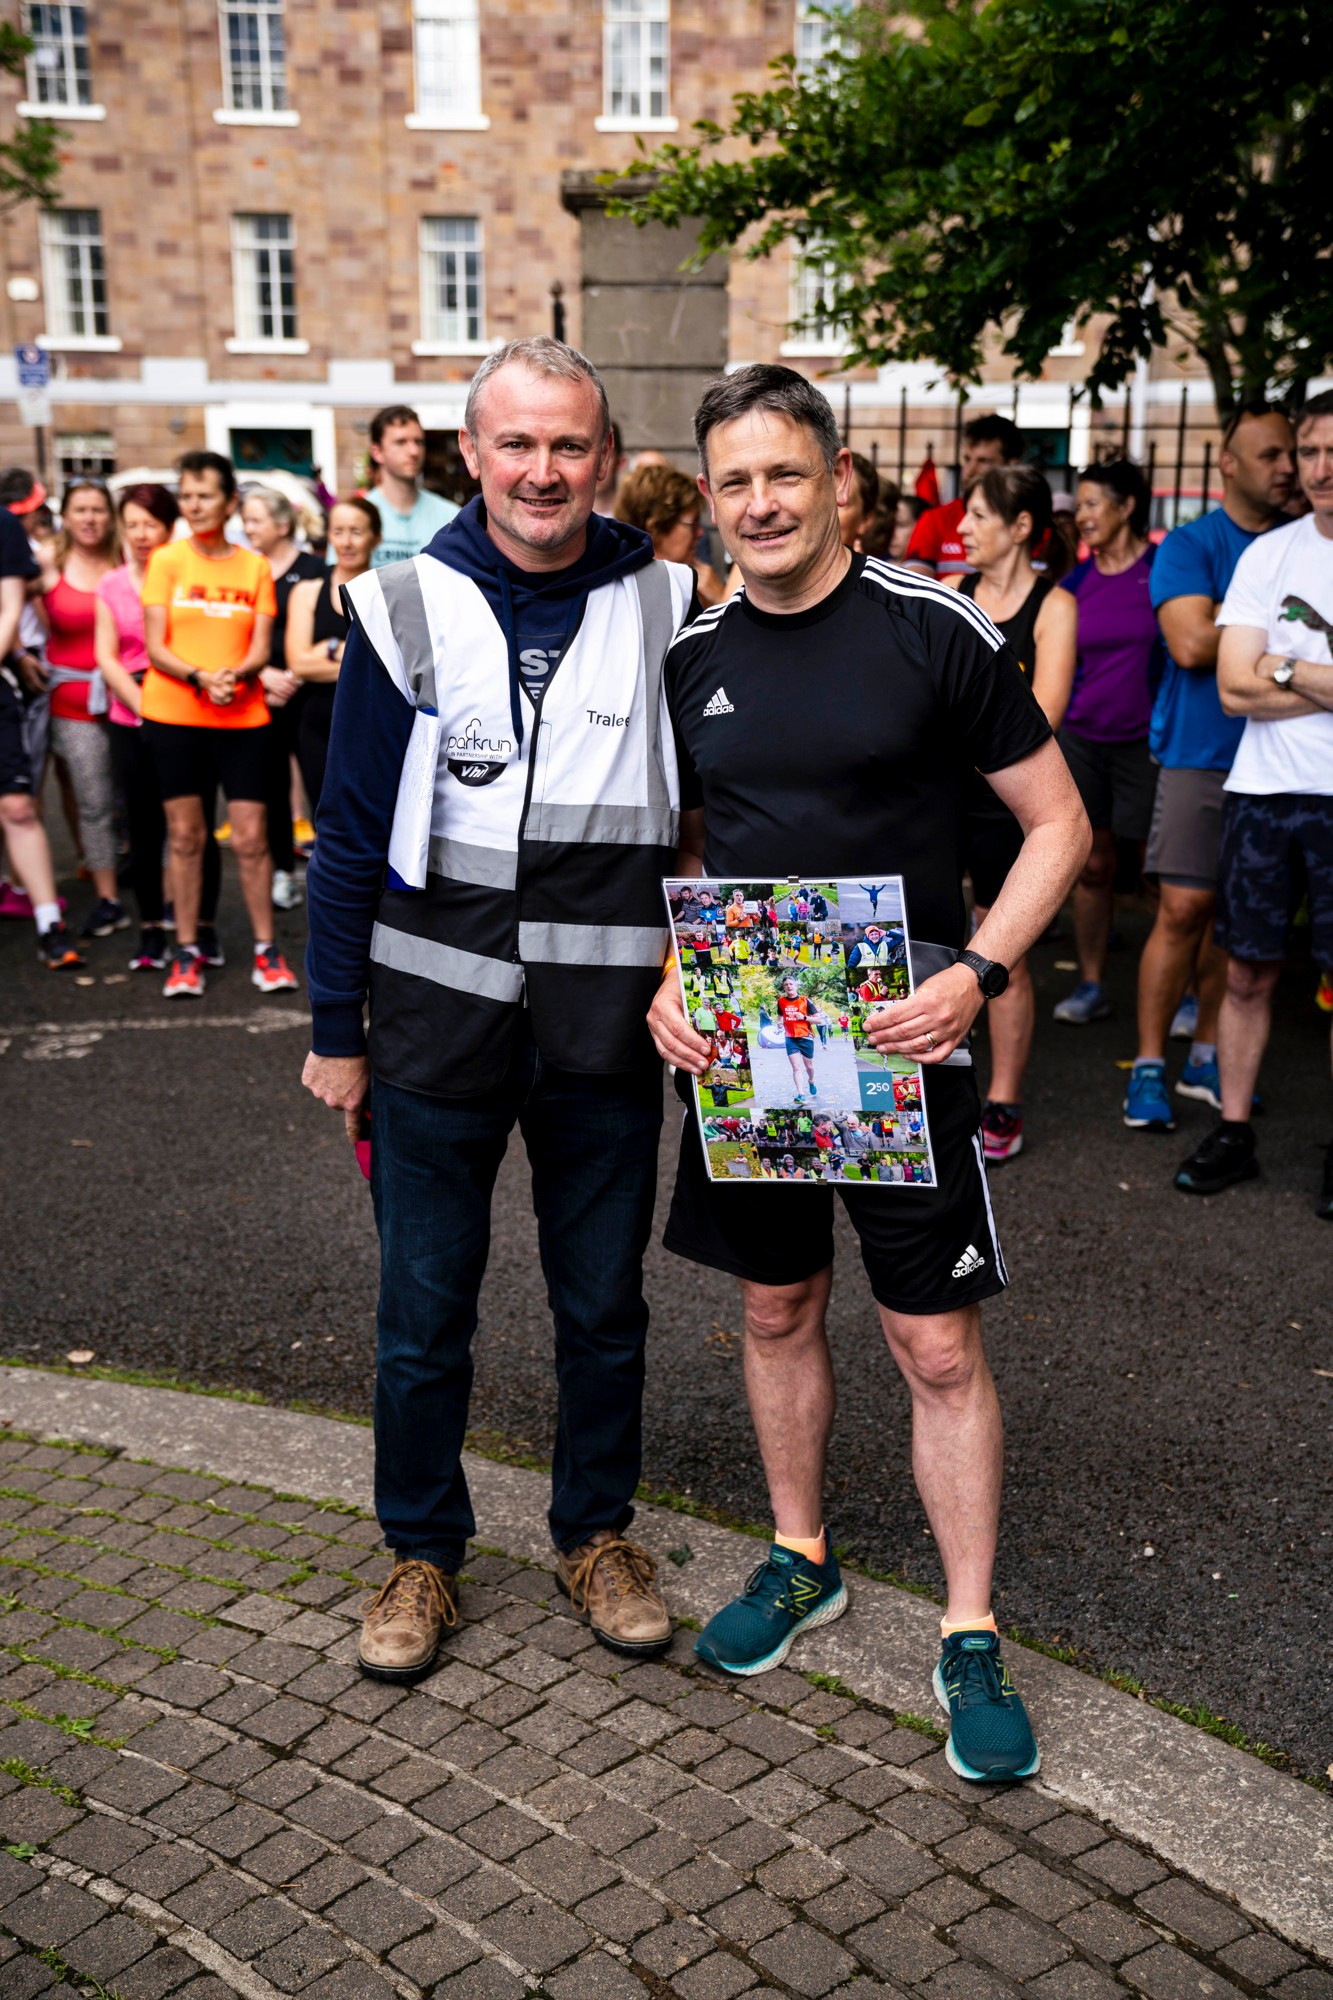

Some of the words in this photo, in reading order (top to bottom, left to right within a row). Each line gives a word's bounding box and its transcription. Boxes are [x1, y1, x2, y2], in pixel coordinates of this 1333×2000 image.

[703, 703, 735, 717] adidas
[445, 728, 512, 752] parkrun
[866, 1082, 890, 1095] 250
[952, 1257, 985, 1278] adidas
